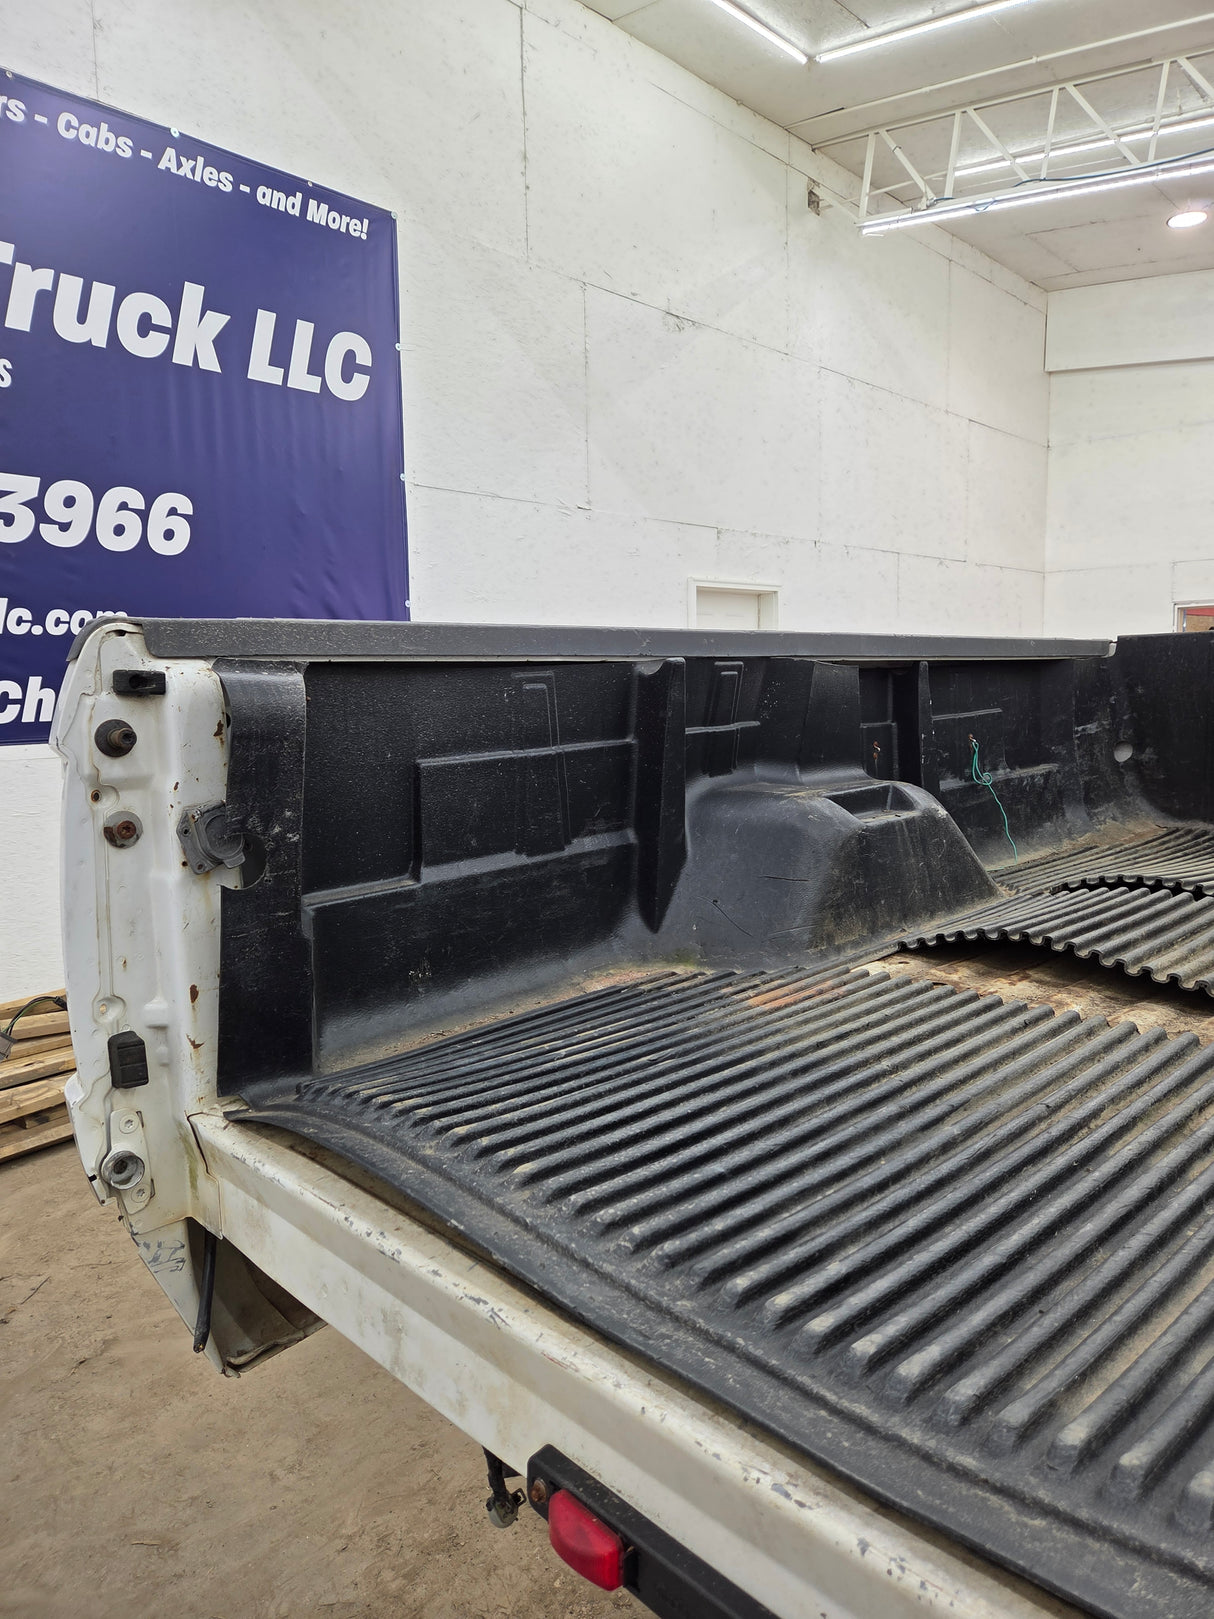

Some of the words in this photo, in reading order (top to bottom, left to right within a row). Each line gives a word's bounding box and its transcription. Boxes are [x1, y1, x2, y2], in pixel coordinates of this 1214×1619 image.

[56, 111, 134, 159] Cabs
[157, 146, 234, 193] Axles
[256, 185, 303, 217] and
[306, 198, 369, 241] More!
[0, 240, 231, 374] ruck
[246, 308, 373, 402] LLC
[0, 472, 194, 556] 3966
